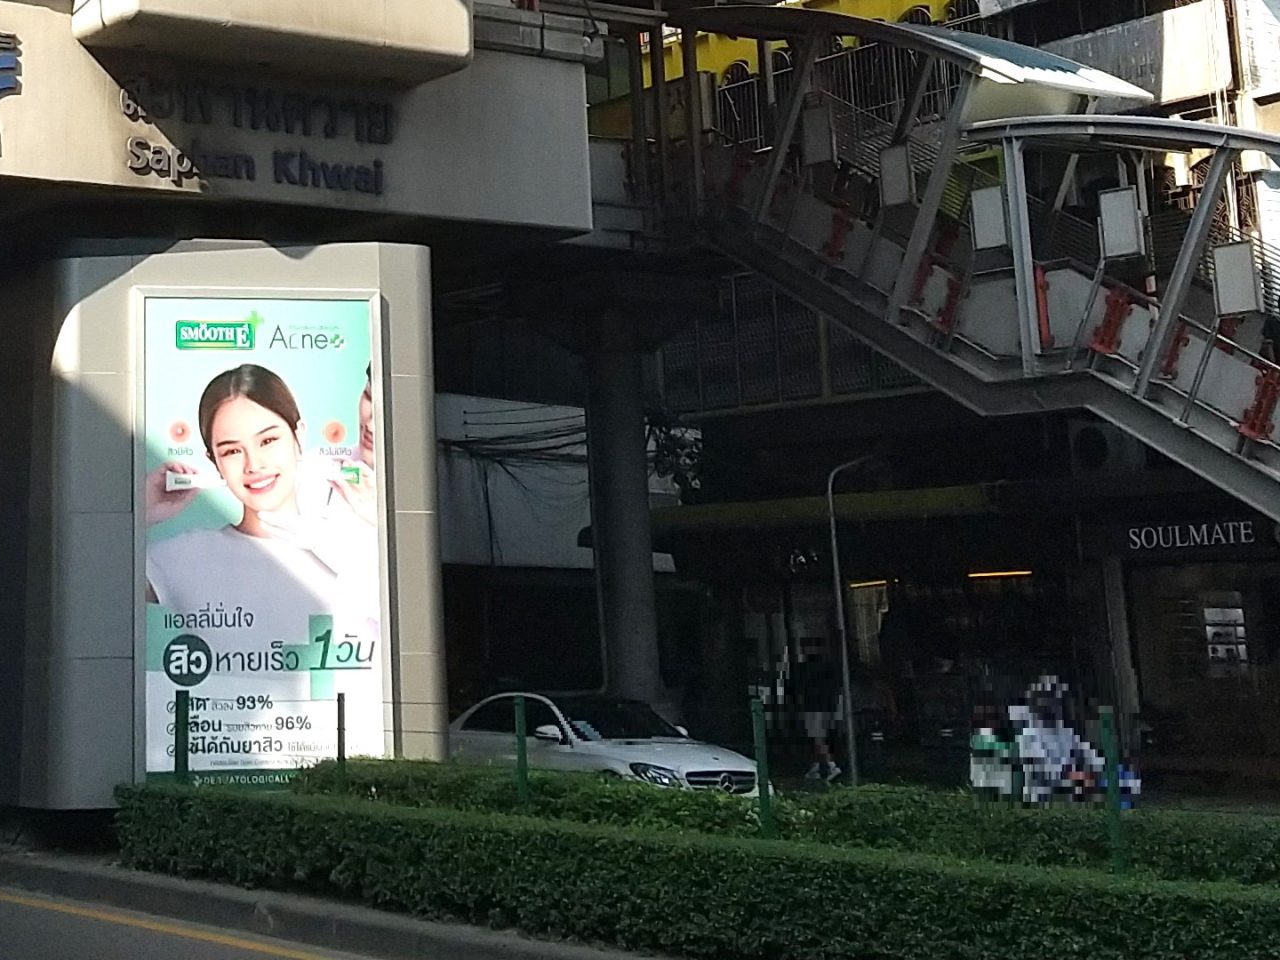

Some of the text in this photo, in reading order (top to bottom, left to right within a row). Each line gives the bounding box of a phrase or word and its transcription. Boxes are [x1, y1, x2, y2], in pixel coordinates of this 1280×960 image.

[128, 136, 384, 195] Saphan Khwai
[269, 324, 329, 350] Acne
[1129, 521, 1255, 550] SOULMATE
[164, 602, 254, 629] แอลลี่มั่นใจ
[169, 629, 376, 675] สิว หายเร็ว 1 วัน
[236, 695, 273, 711] 93%
[189, 715, 222, 733] ลือน
[275, 715, 312, 730] 96%
[188, 736, 282, 755] ช้ได้กับยาสิว
